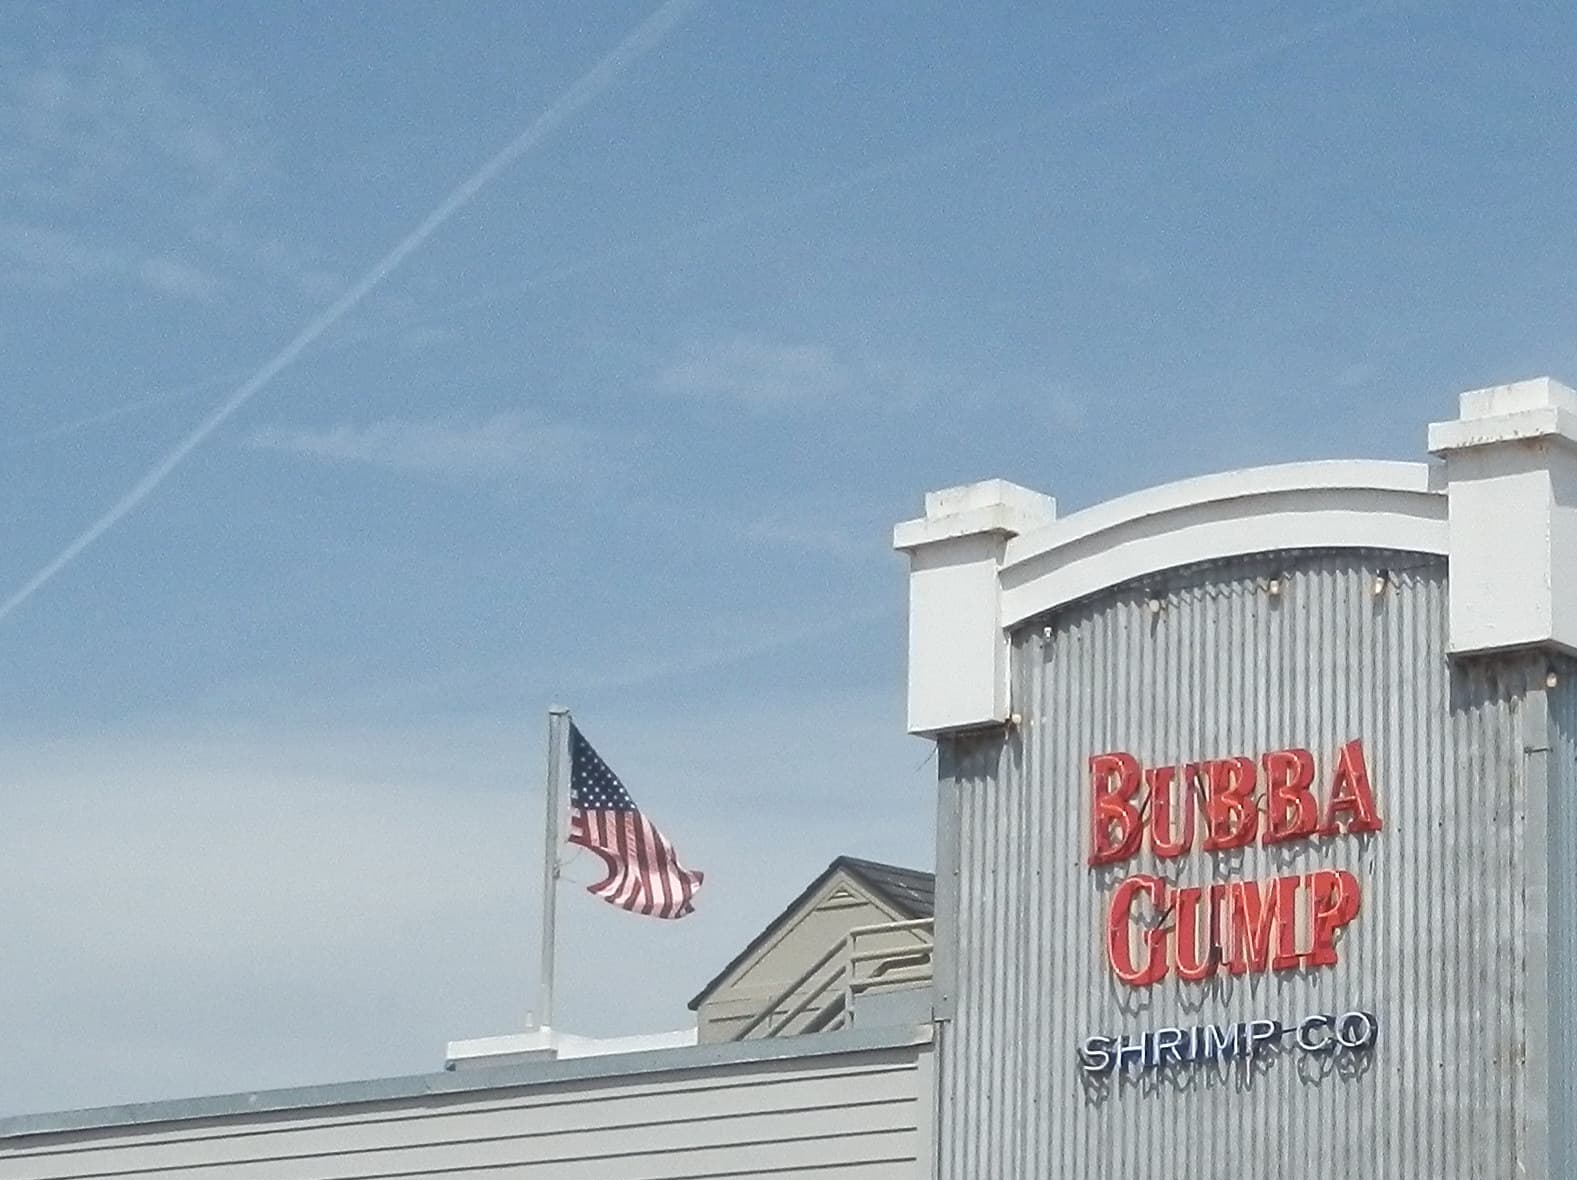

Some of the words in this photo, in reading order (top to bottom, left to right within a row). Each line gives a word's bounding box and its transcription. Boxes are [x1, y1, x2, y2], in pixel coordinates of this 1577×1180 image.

[1088, 738, 1383, 866] BUBBA
[1107, 870, 1362, 986] GUMP
[1082, 1019, 1282, 1074] SHRIMP
[1296, 1011, 1378, 1055] CO
